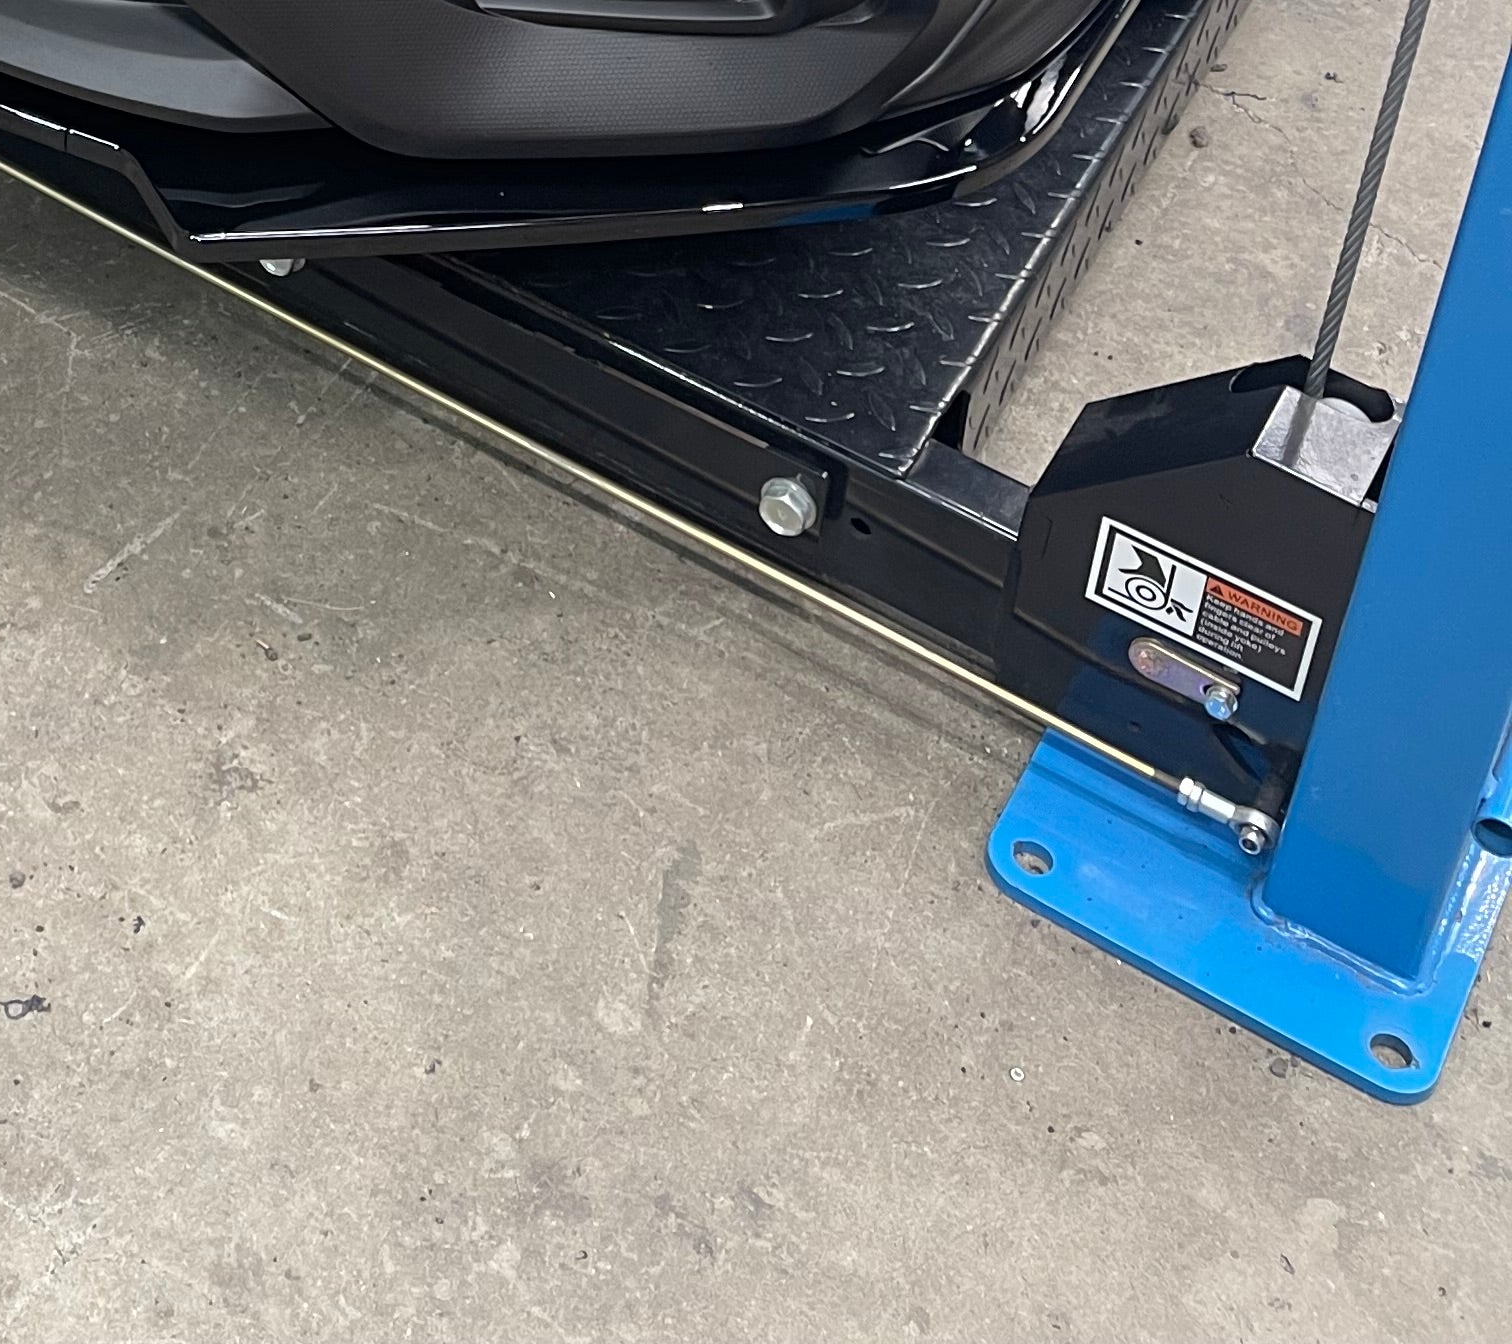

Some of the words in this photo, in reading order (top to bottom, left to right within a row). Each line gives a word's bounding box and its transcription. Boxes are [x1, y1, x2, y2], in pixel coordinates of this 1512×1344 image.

[1204, 601, 1238, 623] fingers
[1239, 618, 1264, 635] clear
[1264, 631, 1276, 641] of
[1206, 594, 1232, 611] Keep
[1234, 607, 1264, 627] hands
[1265, 622, 1285, 637] and
[1228, 591, 1299, 632] WARNING
[1198, 626, 1230, 645] during
[1200, 618, 1233, 638] (inside
[1234, 635, 1262, 653] yoke)
[1202, 610, 1230, 628] cable
[1230, 623, 1250, 638] and
[1250, 633, 1286, 656] pulleys
